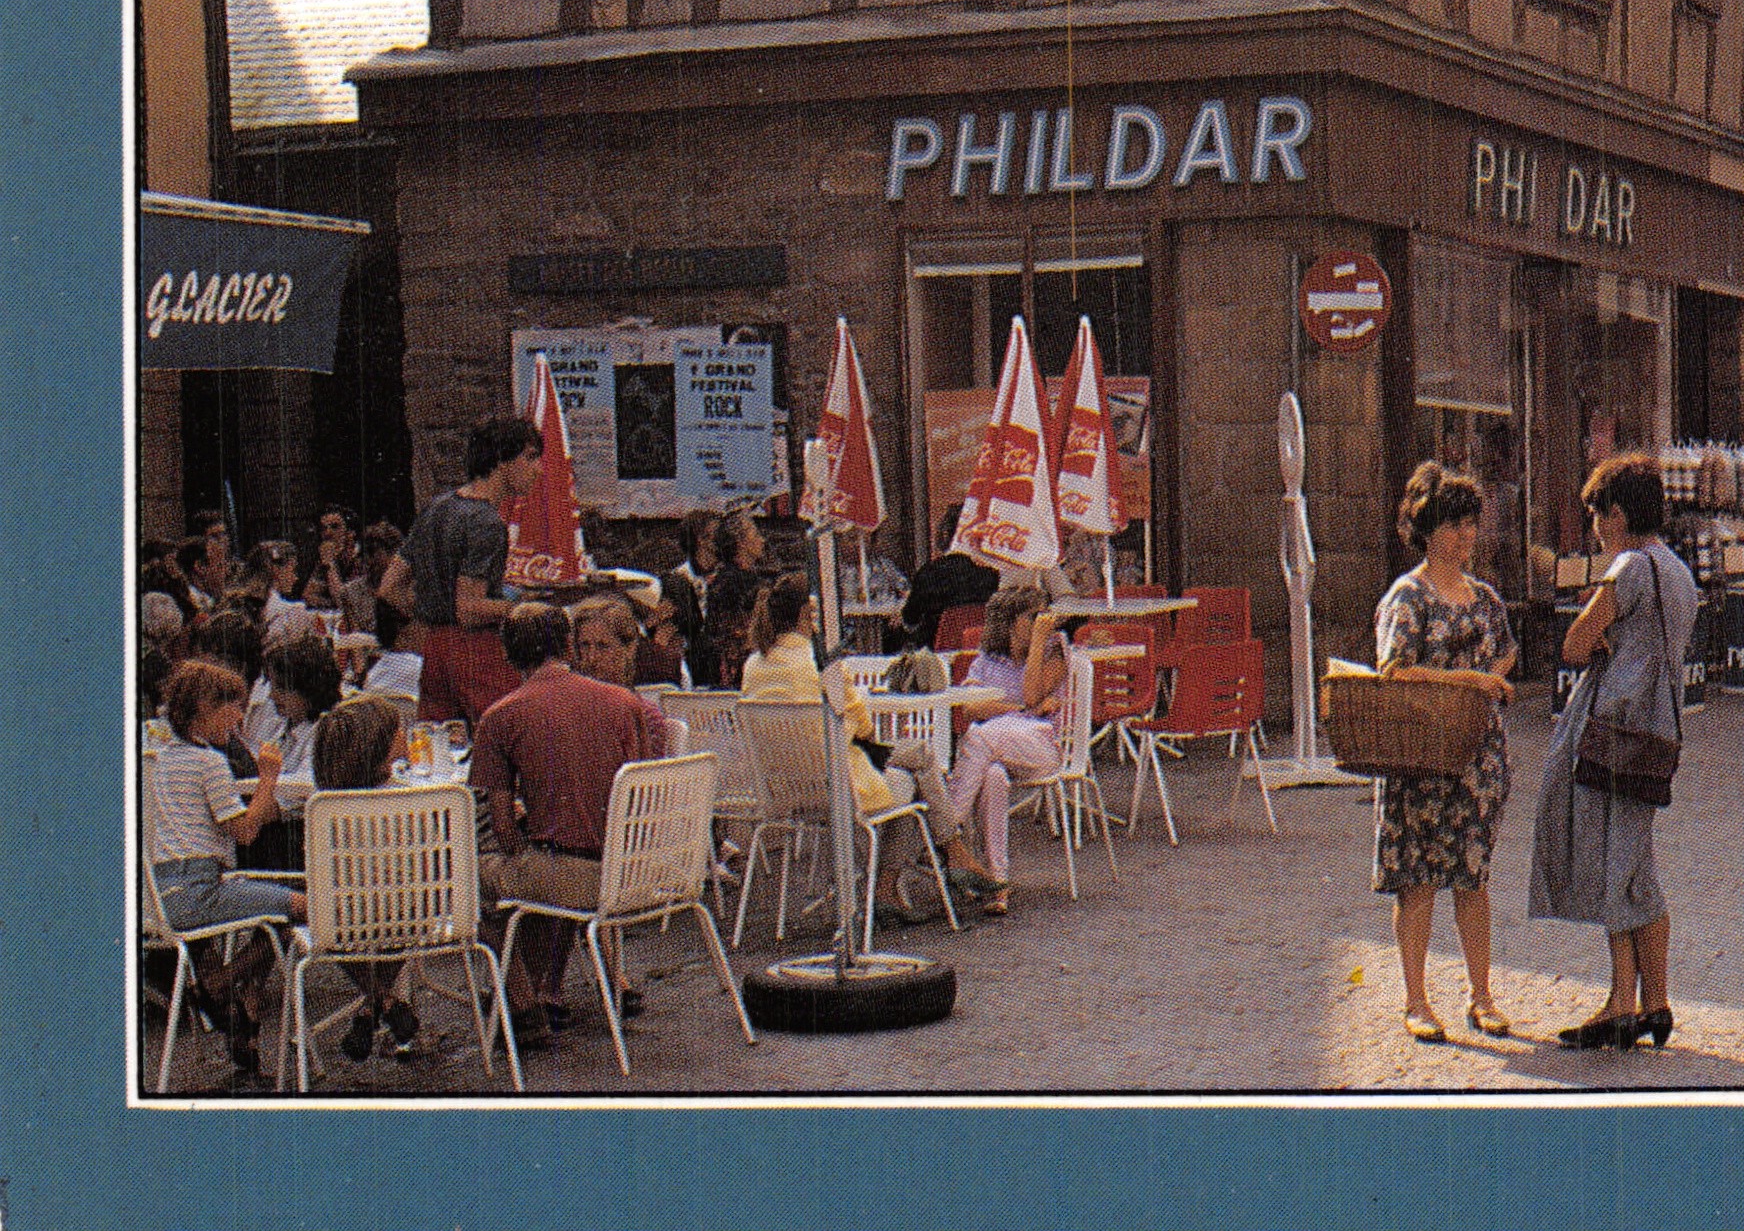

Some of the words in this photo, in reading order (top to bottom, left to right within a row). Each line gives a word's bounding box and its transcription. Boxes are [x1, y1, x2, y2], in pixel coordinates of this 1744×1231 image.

[884, 95, 1312, 201] PHILDAR
[146, 269, 294, 339] GLACIER
[690, 377, 757, 391] FESTIVAL
[703, 393, 742, 419] ROCK
